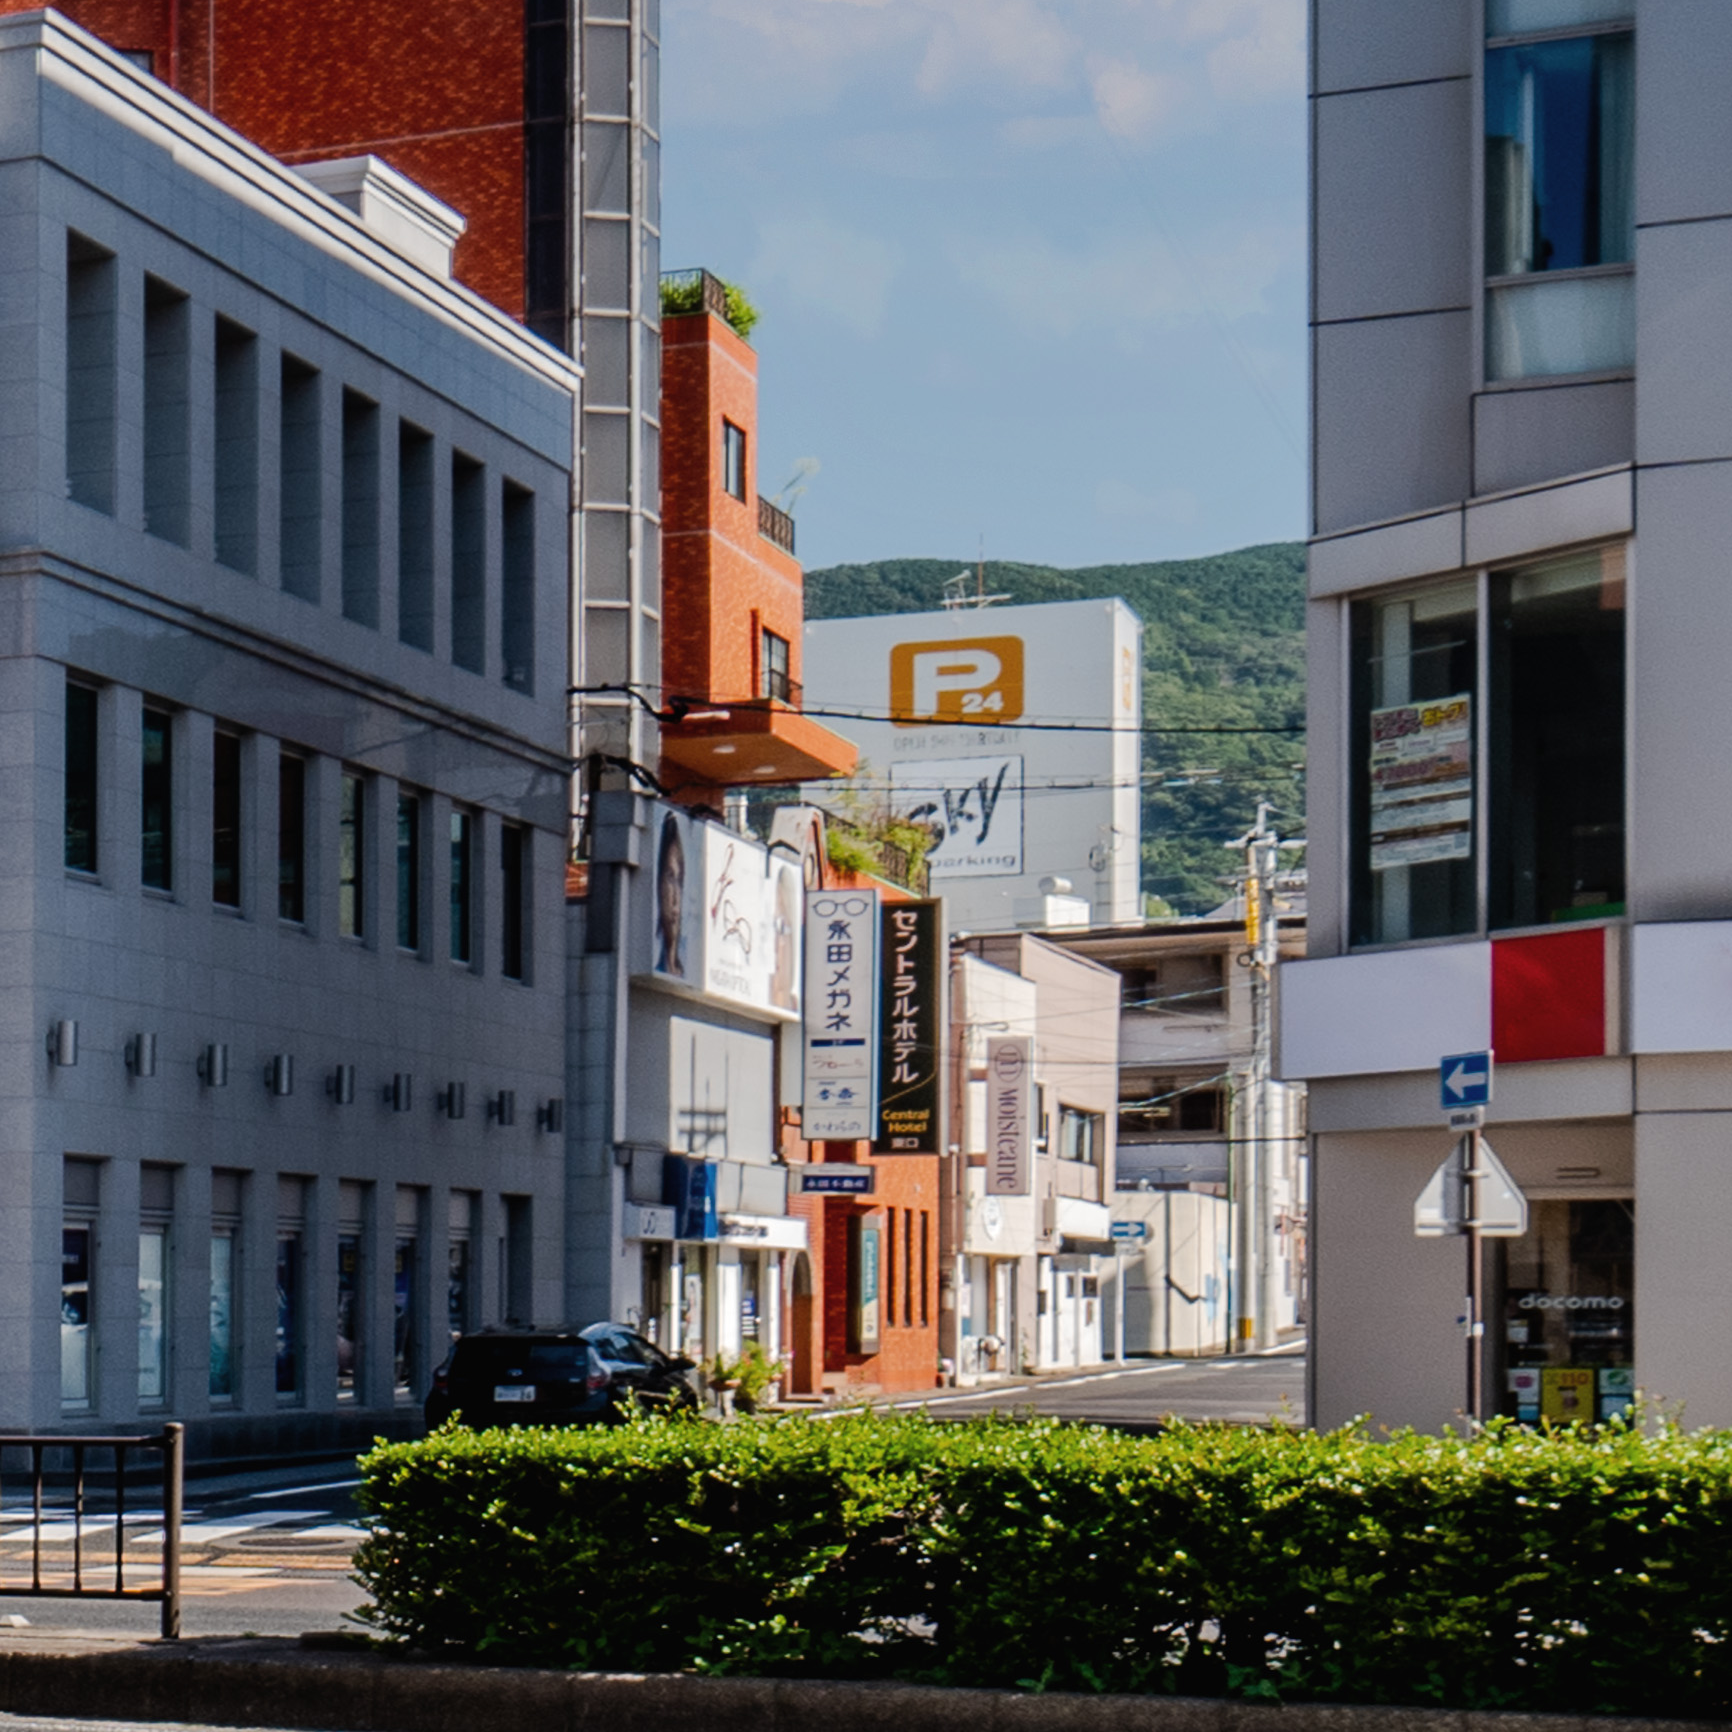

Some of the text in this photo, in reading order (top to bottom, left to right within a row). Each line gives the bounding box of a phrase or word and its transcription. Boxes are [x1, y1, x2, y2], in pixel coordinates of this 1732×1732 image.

[912, 648, 1003, 717] P
[960, 690, 1005, 715] 24
[824, 919, 854, 1032] 永田メガネ
[891, 908, 920, 1084] セントラルホテル
[882, 1108, 931, 1122] Central
[888, 1121, 928, 1134] Hotel
[1518, 1292, 1624, 1309] docomo
